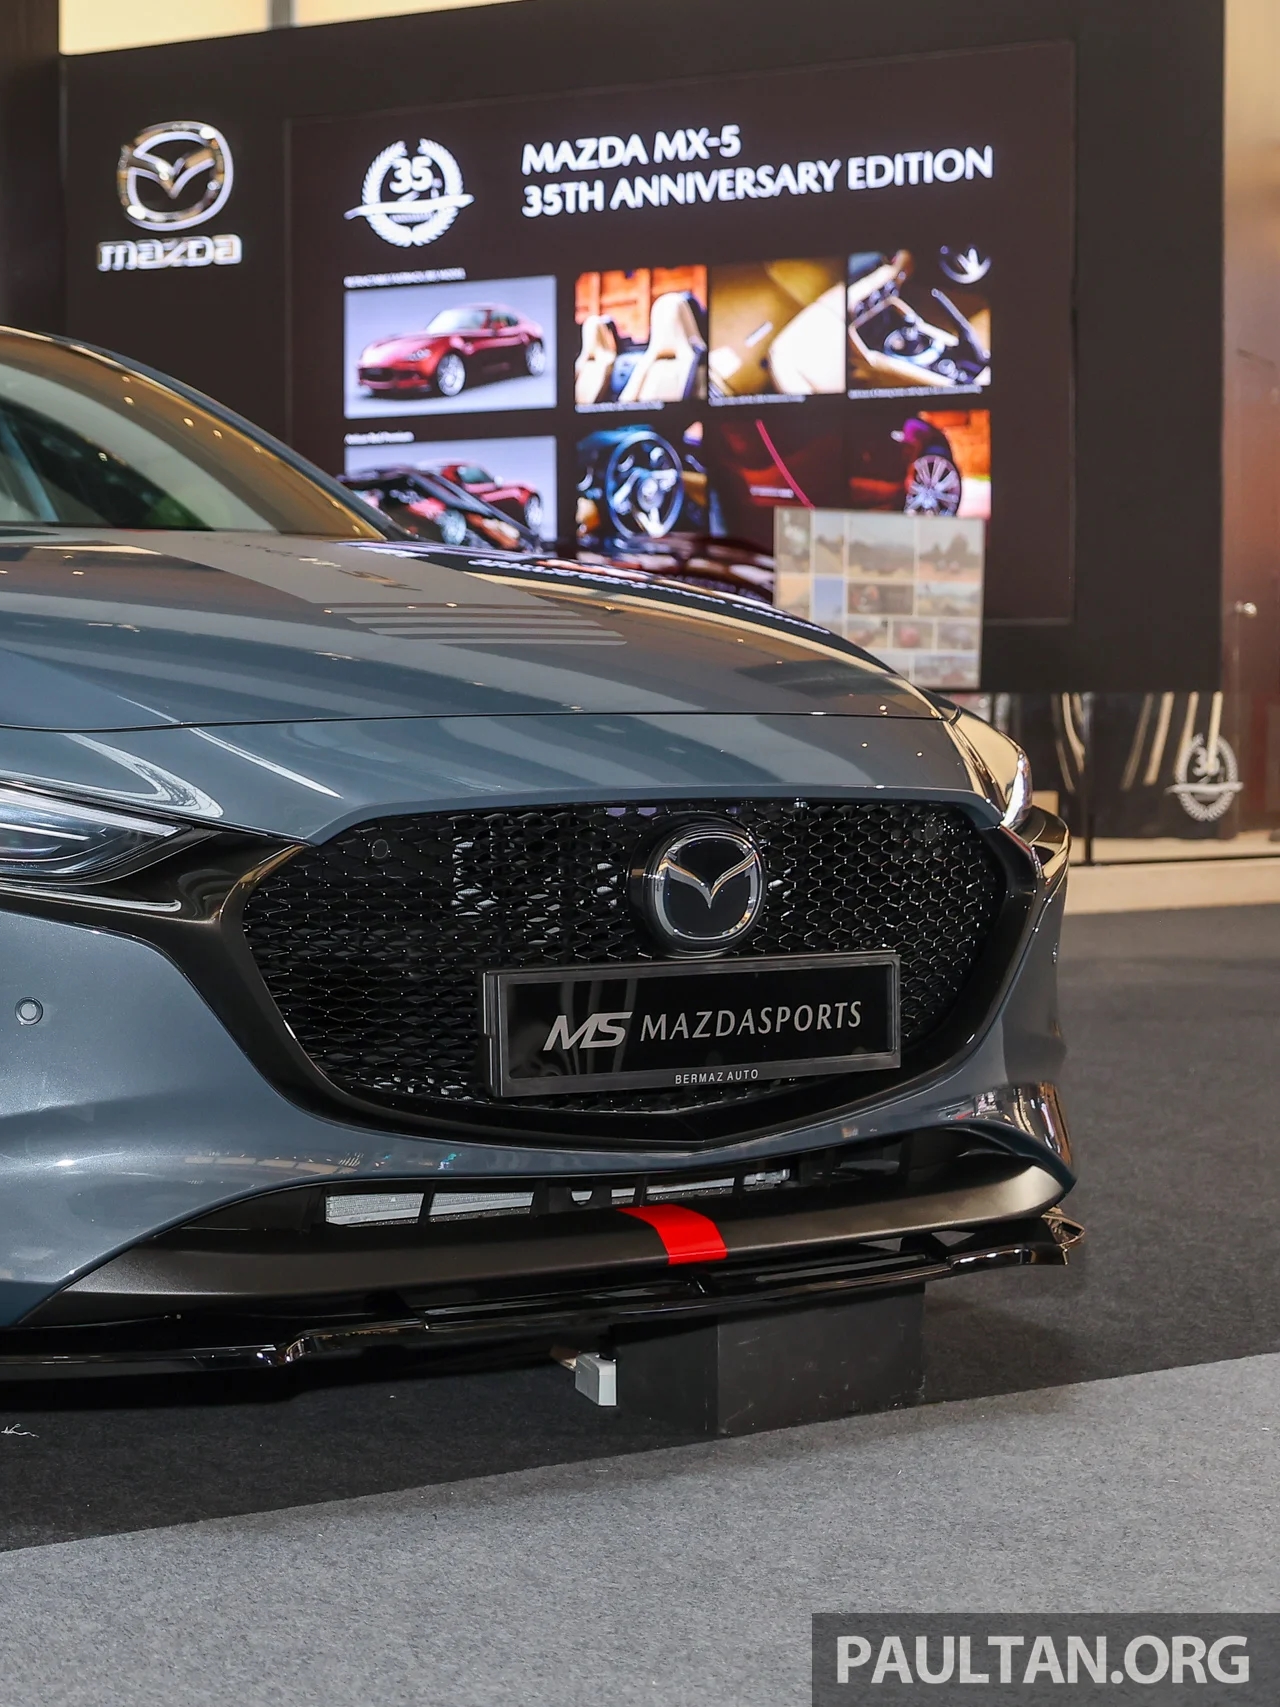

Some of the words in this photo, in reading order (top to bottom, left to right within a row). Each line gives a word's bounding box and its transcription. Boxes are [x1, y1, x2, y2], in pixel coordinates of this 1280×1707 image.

[521, 133, 647, 176] MAZDA
[653, 124, 742, 163] MX-5
[389, 155, 434, 194] 35
[521, 179, 605, 218] 35TH
[610, 158, 841, 211] ANNIVERSARY
[847, 145, 994, 191] EDITION
[97, 234, 242, 272] mazda
[543, 1011, 632, 1051] MS
[640, 1000, 863, 1042] MAZDASPORTS
[675, 1072, 724, 1085] BERMAZ
[726, 1069, 759, 1081] AUTO
